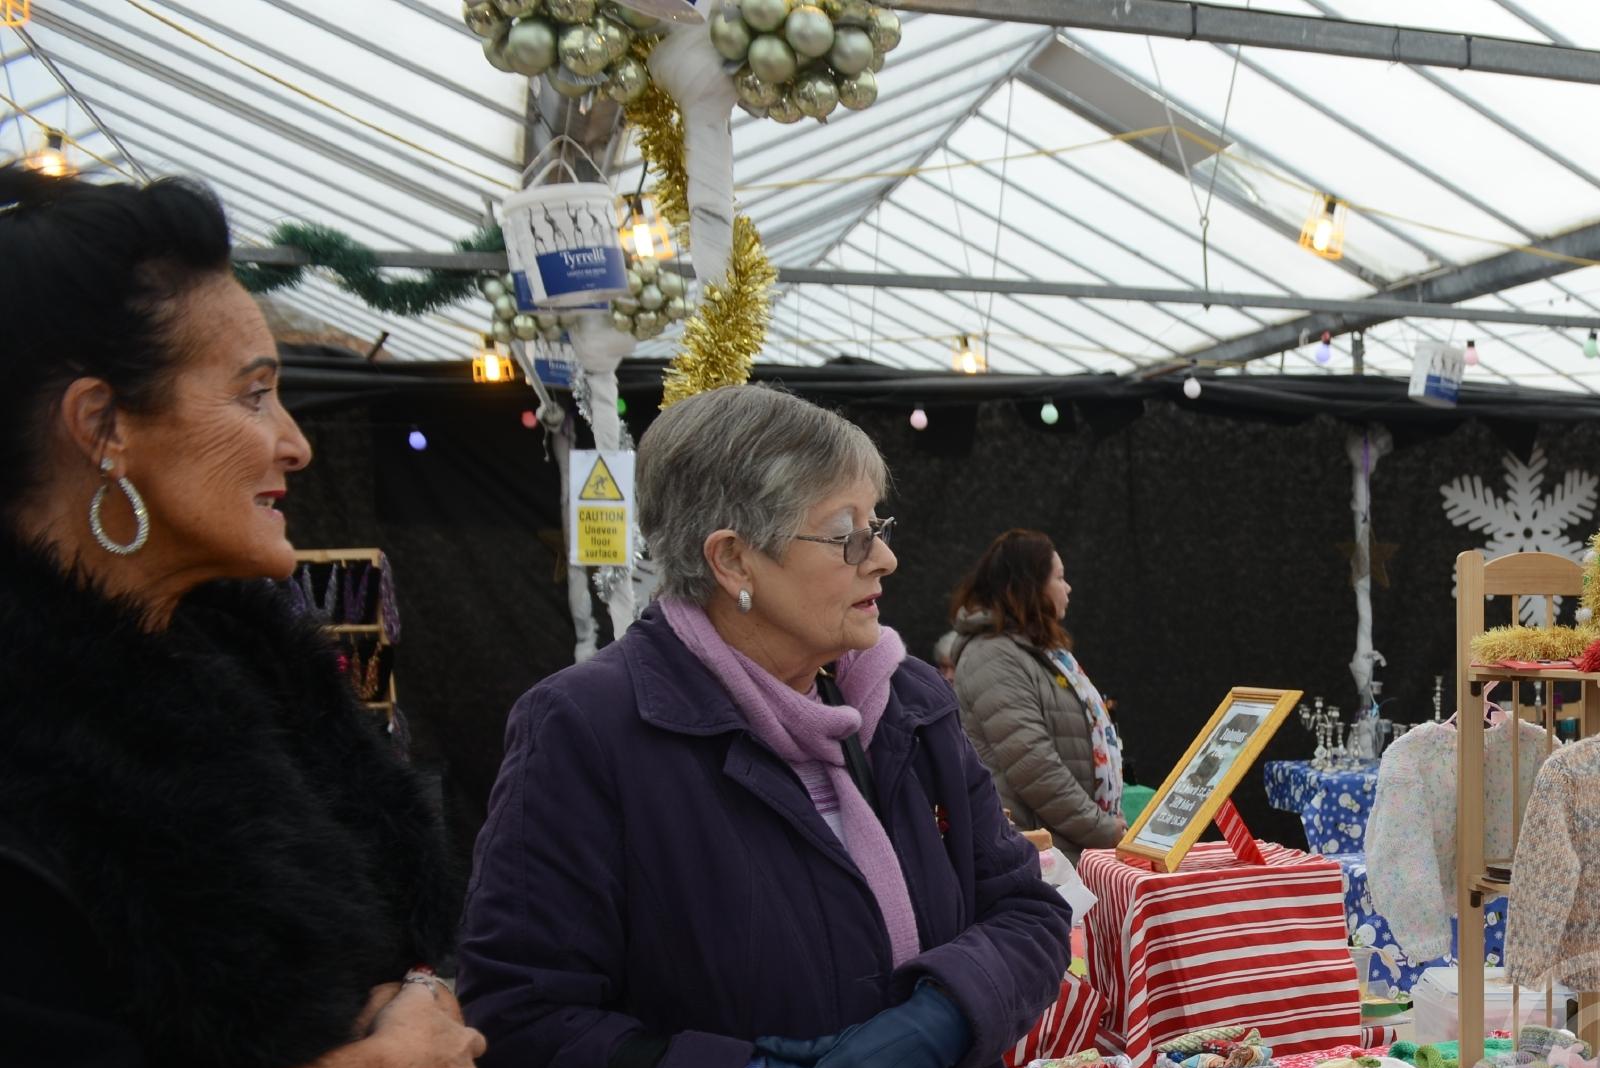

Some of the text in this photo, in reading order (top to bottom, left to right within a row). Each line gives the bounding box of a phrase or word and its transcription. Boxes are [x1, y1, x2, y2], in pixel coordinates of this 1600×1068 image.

[579, 511, 624, 521] CAUTION
[584, 525, 617, 535] Uneven
[591, 537, 611, 546] floor
[585, 548, 618, 559] surface
